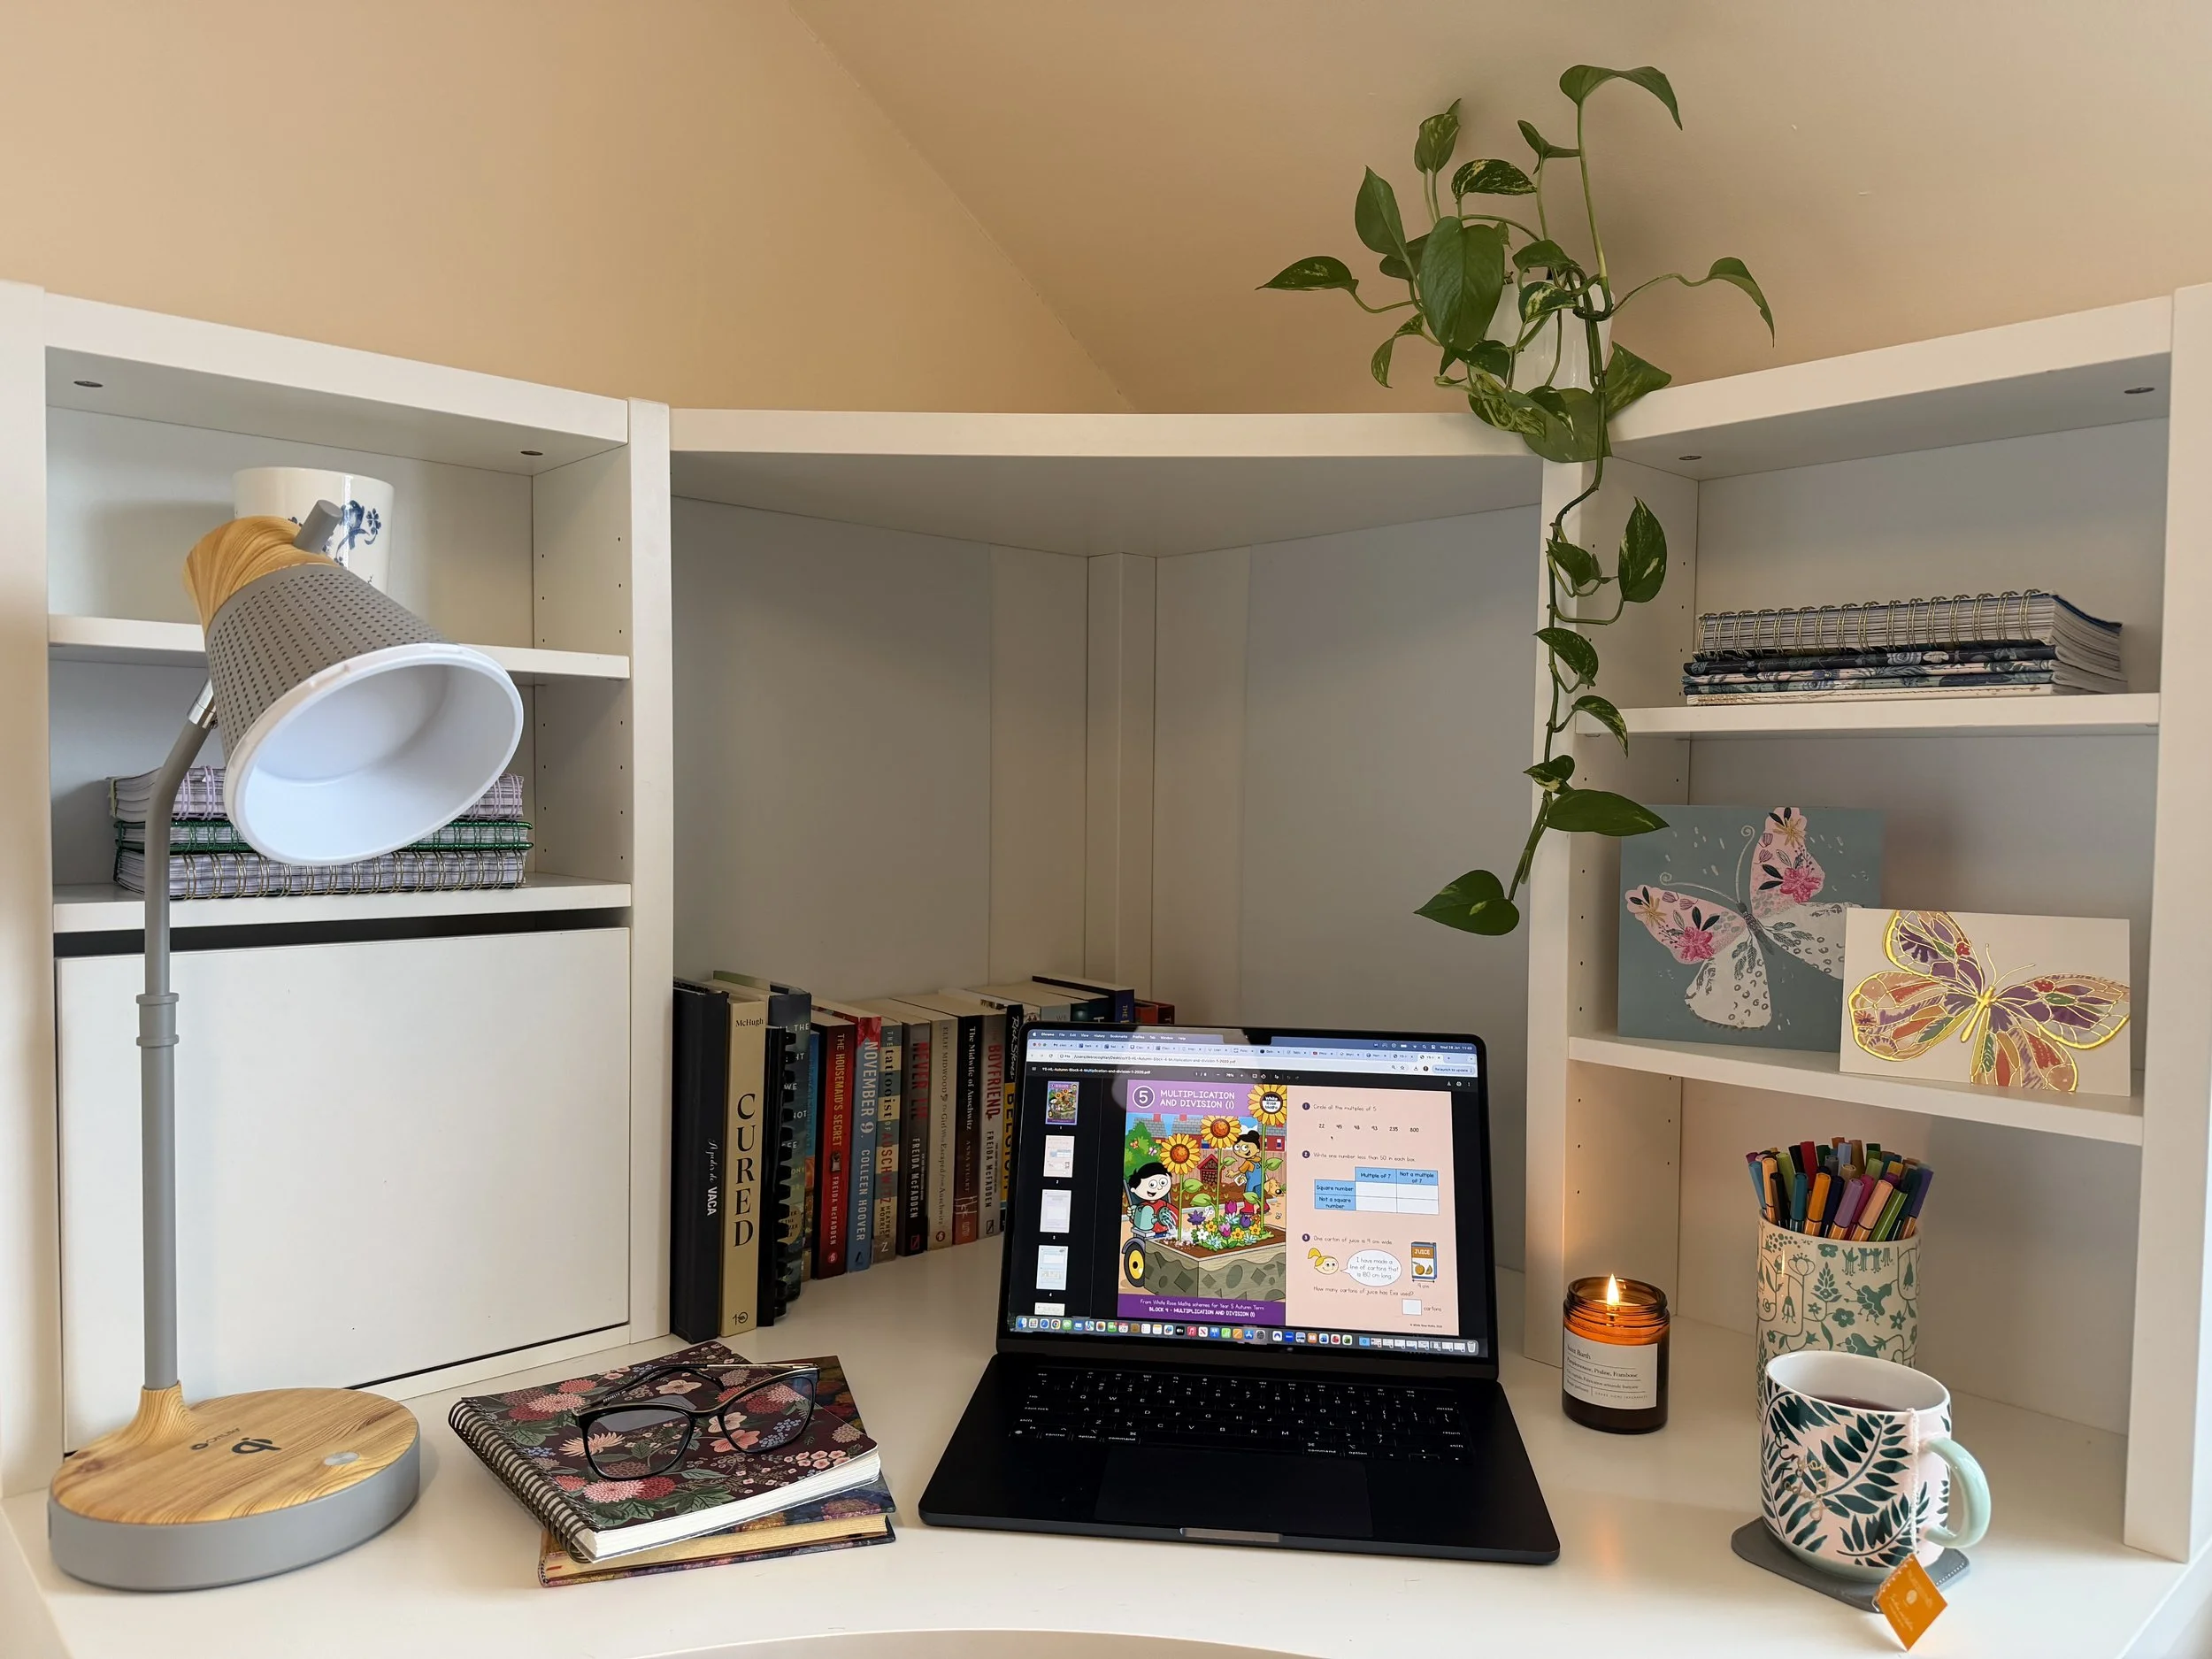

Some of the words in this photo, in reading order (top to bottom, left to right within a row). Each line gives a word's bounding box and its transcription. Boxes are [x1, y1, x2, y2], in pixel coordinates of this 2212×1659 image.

[735, 1018, 764, 1027] McHugh
[837, 1033, 845, 1050] THE
[860, 1041, 879, 1117] NOVEMBER
[912, 1042, 929, 1089] NEVER
[987, 1045, 1002, 1117] BOYFRIEND
[833, 1054, 845, 1111] HOUSEMAID'S
[884, 1049, 895, 1118] tattooist
[967, 1079, 975, 1087] of
[1139, 1090, 1148, 1104] 5
[1160, 1090, 1235, 1100] MULTIPLICATION
[793, 1110, 807, 1118] OT
[911, 1097, 928, 1120] LIE
[1180, 1100, 1222, 1108] DIVISION
[832, 1114, 843, 1146] SECRET
[884, 1120, 891, 1131] OF
[879, 1133, 893, 1205] AUSCHWITZ
[911, 1138, 921, 1169] FREIDA
[938, 1143, 947, 1173] Escaped
[709, 1173, 718, 1182] de
[733, 1093, 756, 1247] CURED
[859, 1149, 870, 1195] COLLEEN
[707, 1186, 718, 1216] VACA
[910, 1171, 920, 1218] McFADDEN
[830, 1206, 838, 1245] McFADDEN
[856, 1199, 867, 1240] HOOVER
